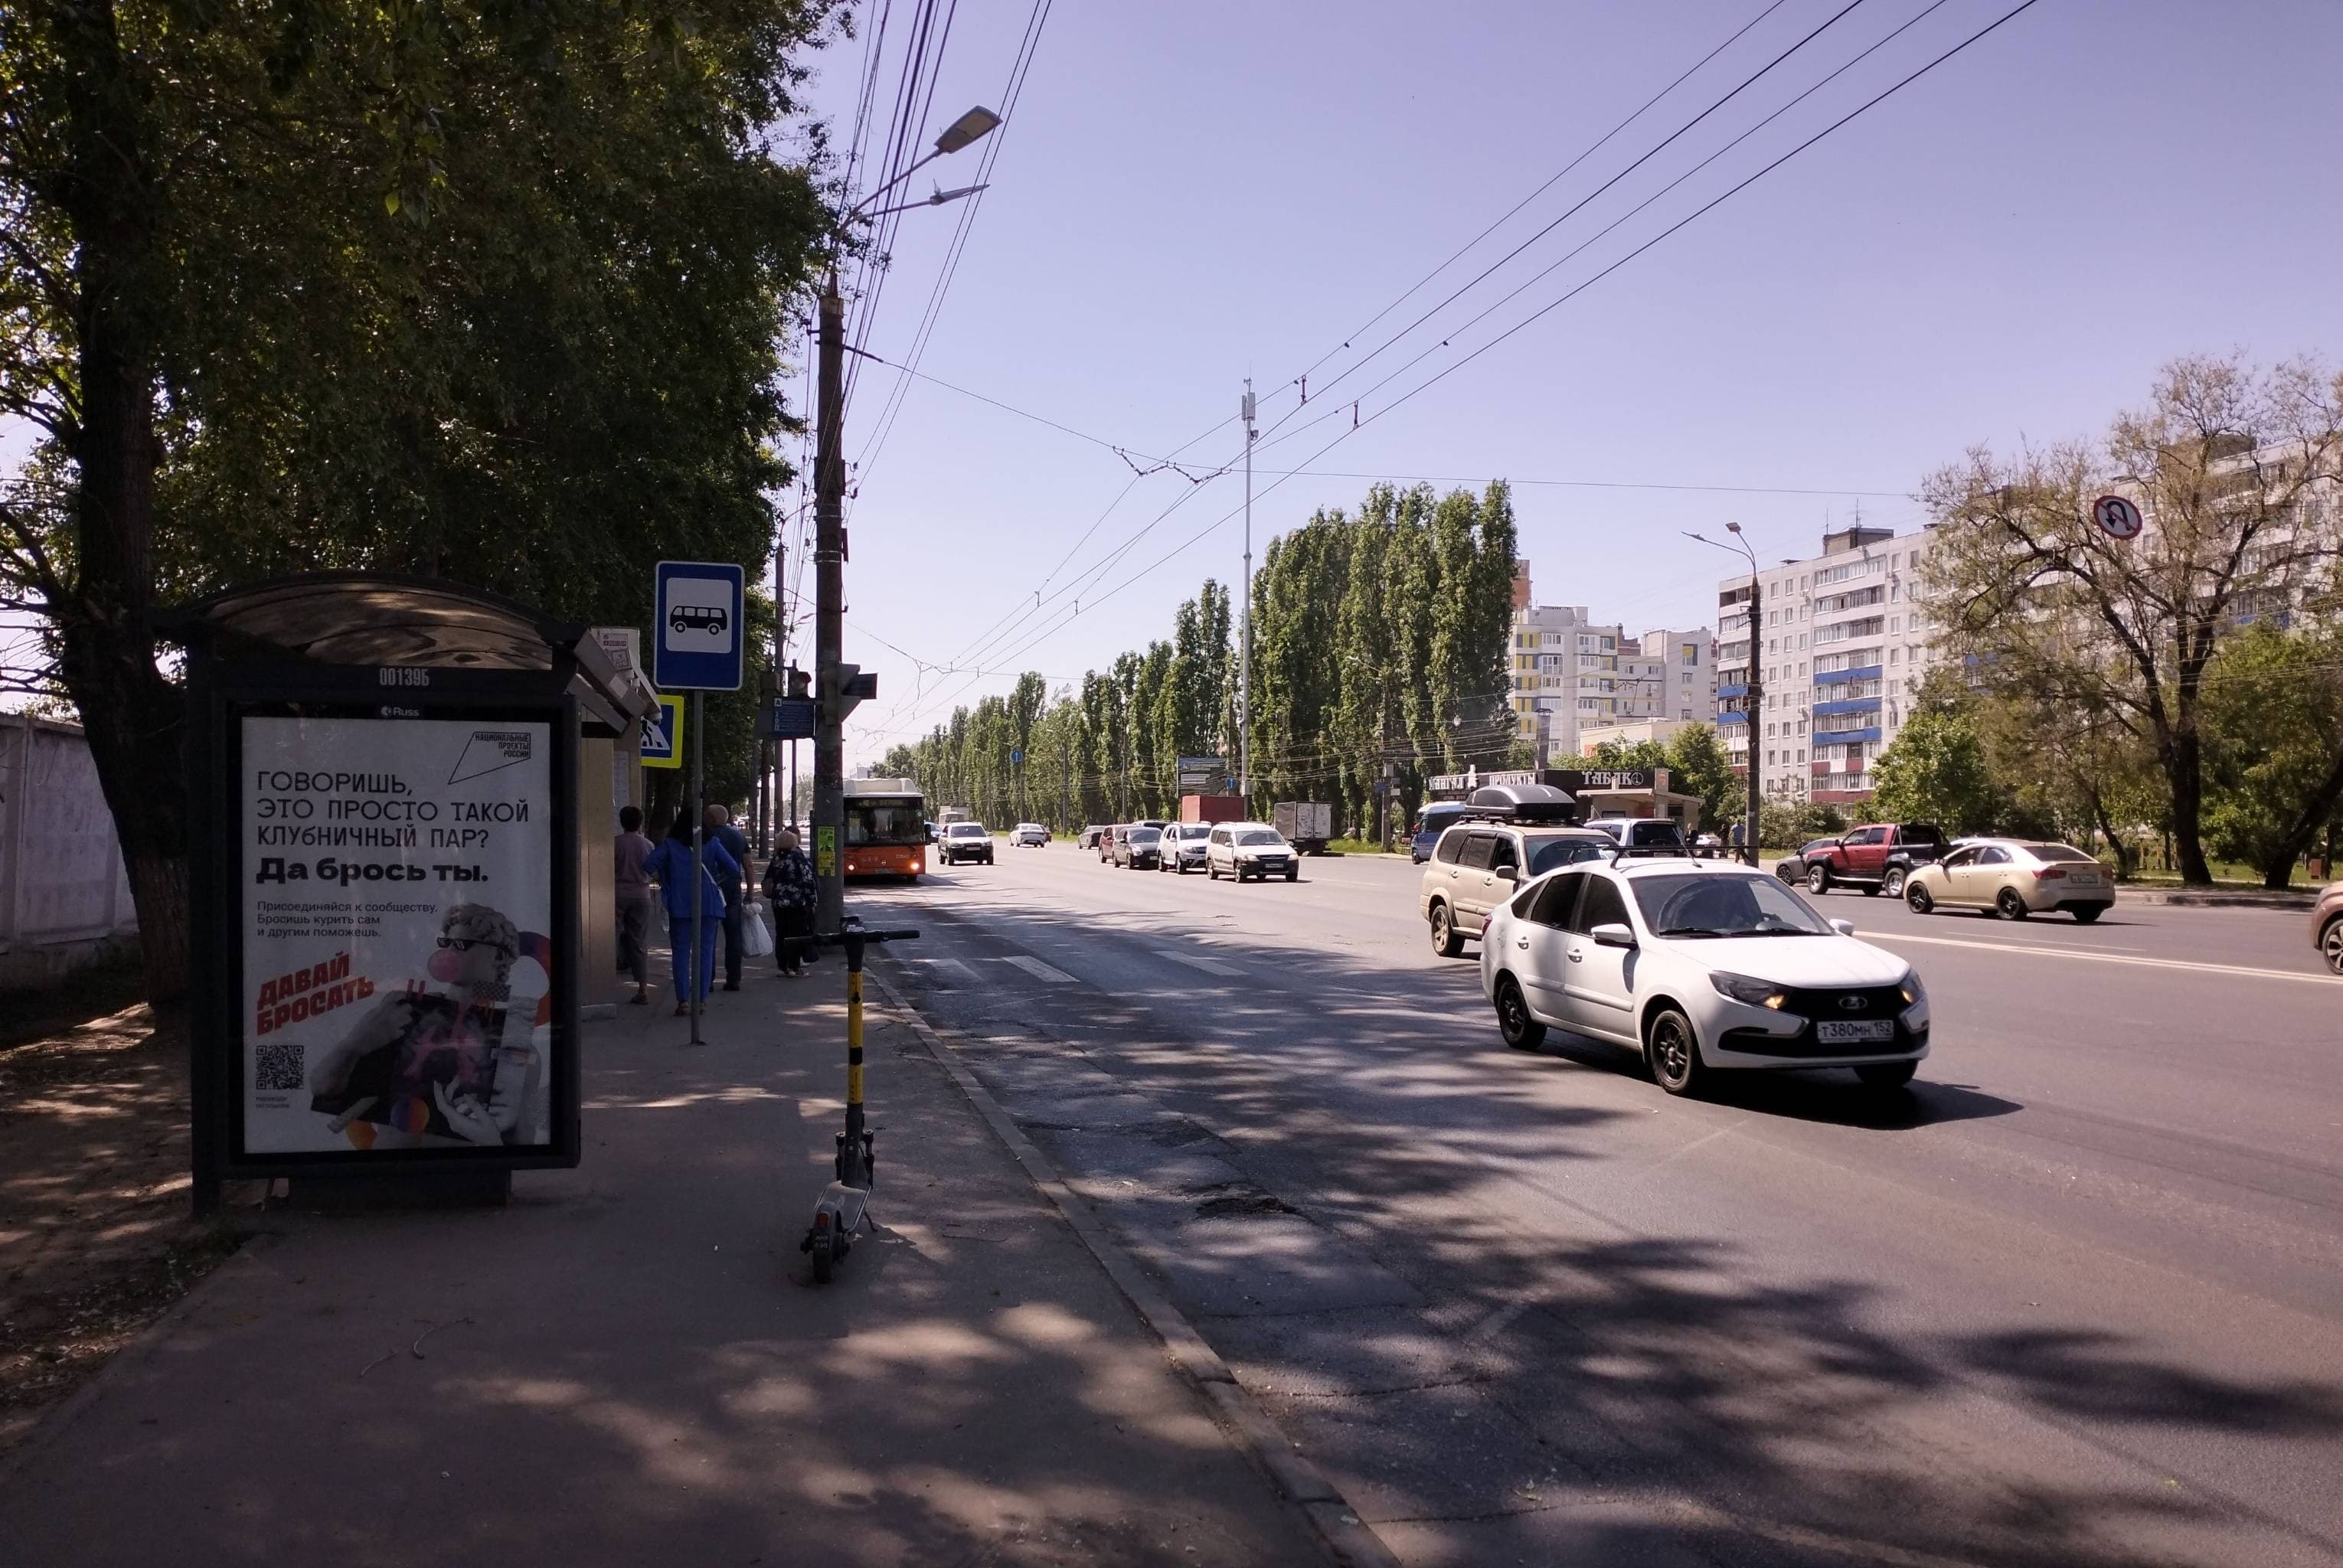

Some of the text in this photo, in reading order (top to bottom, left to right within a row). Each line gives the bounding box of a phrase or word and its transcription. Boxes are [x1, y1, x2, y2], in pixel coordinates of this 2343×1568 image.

[393, 707, 420, 717] Russ
[475, 733, 529, 742] НАЦИОНАЛЬНЫЕ
[257, 771, 413, 795] ГОВОРИШЬ,
[1489, 773, 1535, 786] ПРОДУКТЫ
[1581, 771, 1632, 785] ТАБАК
[257, 799, 529, 822] ЭТО ПРОСТО ТАКОЙ
[430, 828, 489, 848] ПАР?
[256, 857, 489, 886] Да брось ты.
[257, 901, 351, 913] Присоединяйся
[364, 902, 437, 913] сообществу.
[257, 914, 310, 925] Бросишь
[313, 916, 355, 926] курить
[268, 929, 309, 939] другим
[313, 929, 381, 937] поможешь.
[257, 951, 349, 1011] ДАВАЙ
[257, 975, 374, 1036] БРОСАТЬ
[1874, 1021, 1891, 1034] 152
